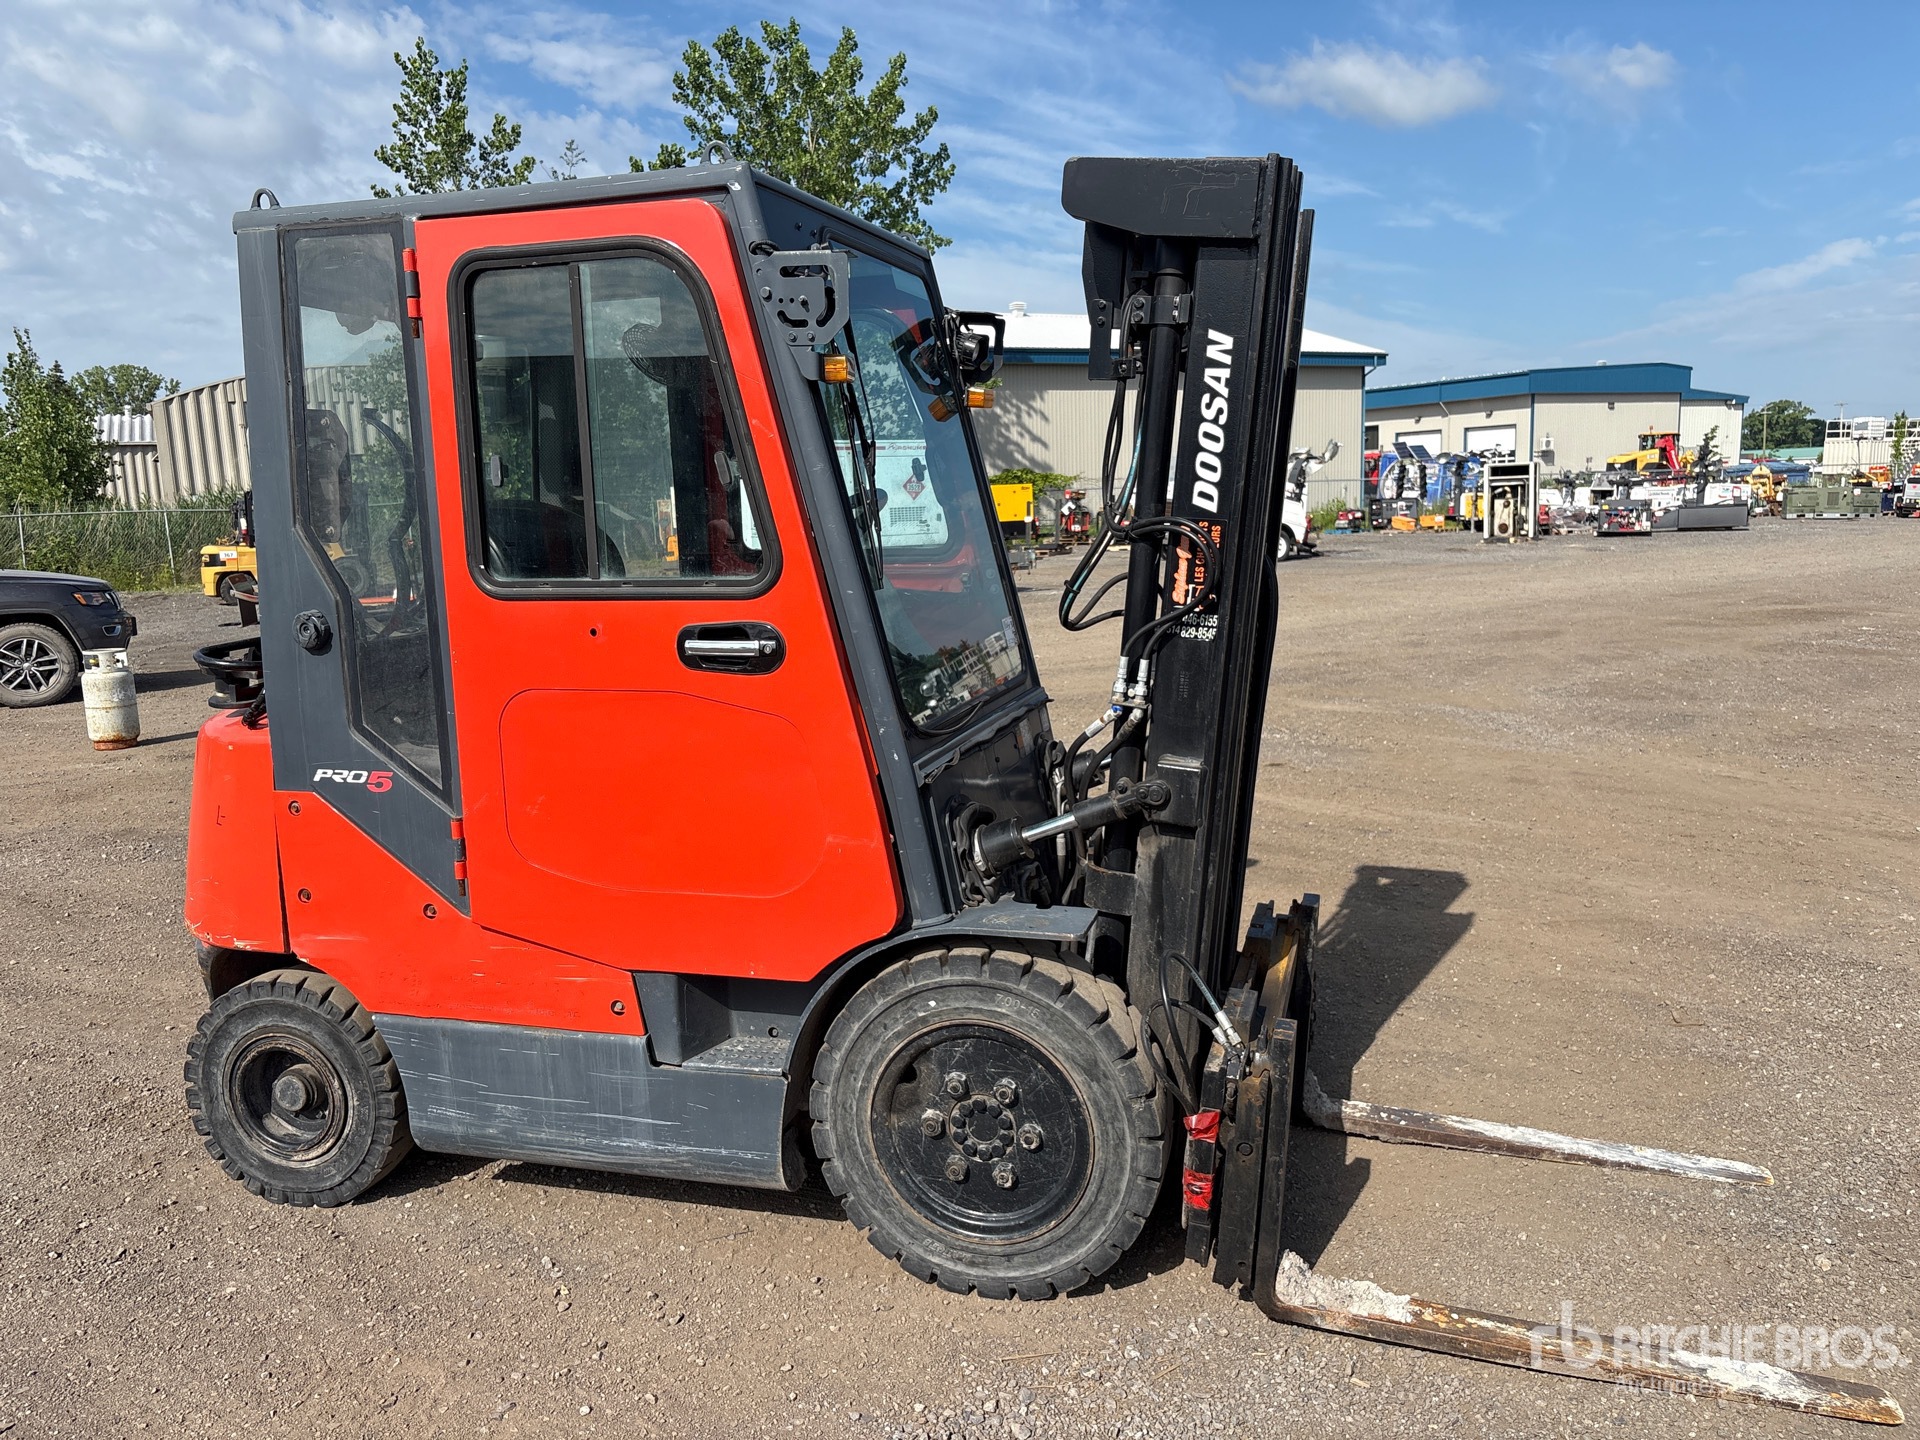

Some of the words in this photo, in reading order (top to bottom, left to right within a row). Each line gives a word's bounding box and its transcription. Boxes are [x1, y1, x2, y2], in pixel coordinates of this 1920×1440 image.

[1192, 328, 1234, 513] DOOSAN
[313, 768, 394, 793] PRO5
[995, 993, 1041, 1019] 7.00-15
